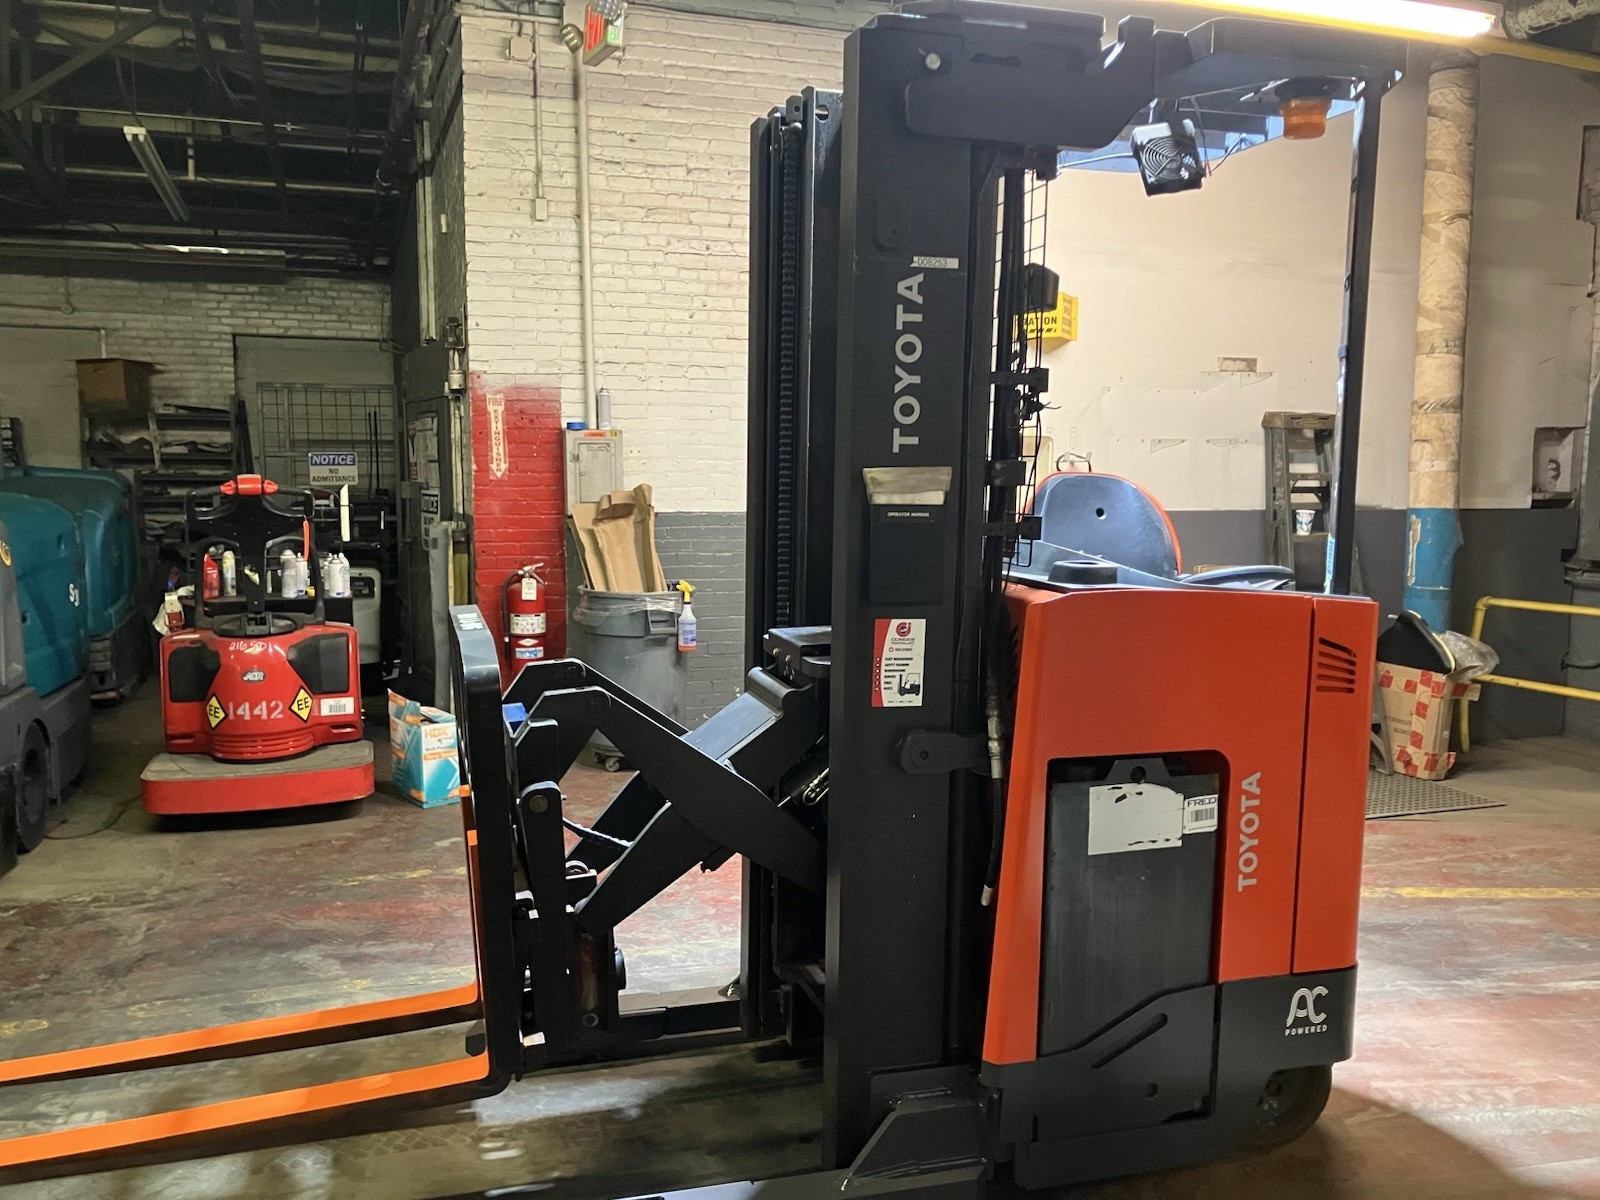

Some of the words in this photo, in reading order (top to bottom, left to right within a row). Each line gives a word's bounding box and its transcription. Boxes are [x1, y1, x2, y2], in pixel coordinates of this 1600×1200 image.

[892, 272, 925, 453] TOYOTA
[488, 397, 503, 406] FIRE
[312, 455, 355, 465] NOTICE
[311, 475, 357, 483] ADMITTANCE
[208, 704, 221, 719] EE
[227, 699, 284, 721] 1442
[296, 697, 310, 712] EE
[1237, 771, 1262, 892] TOYOTA
[1286, 985, 1330, 1028] AC
[1284, 1024, 1328, 1037] POWERED
